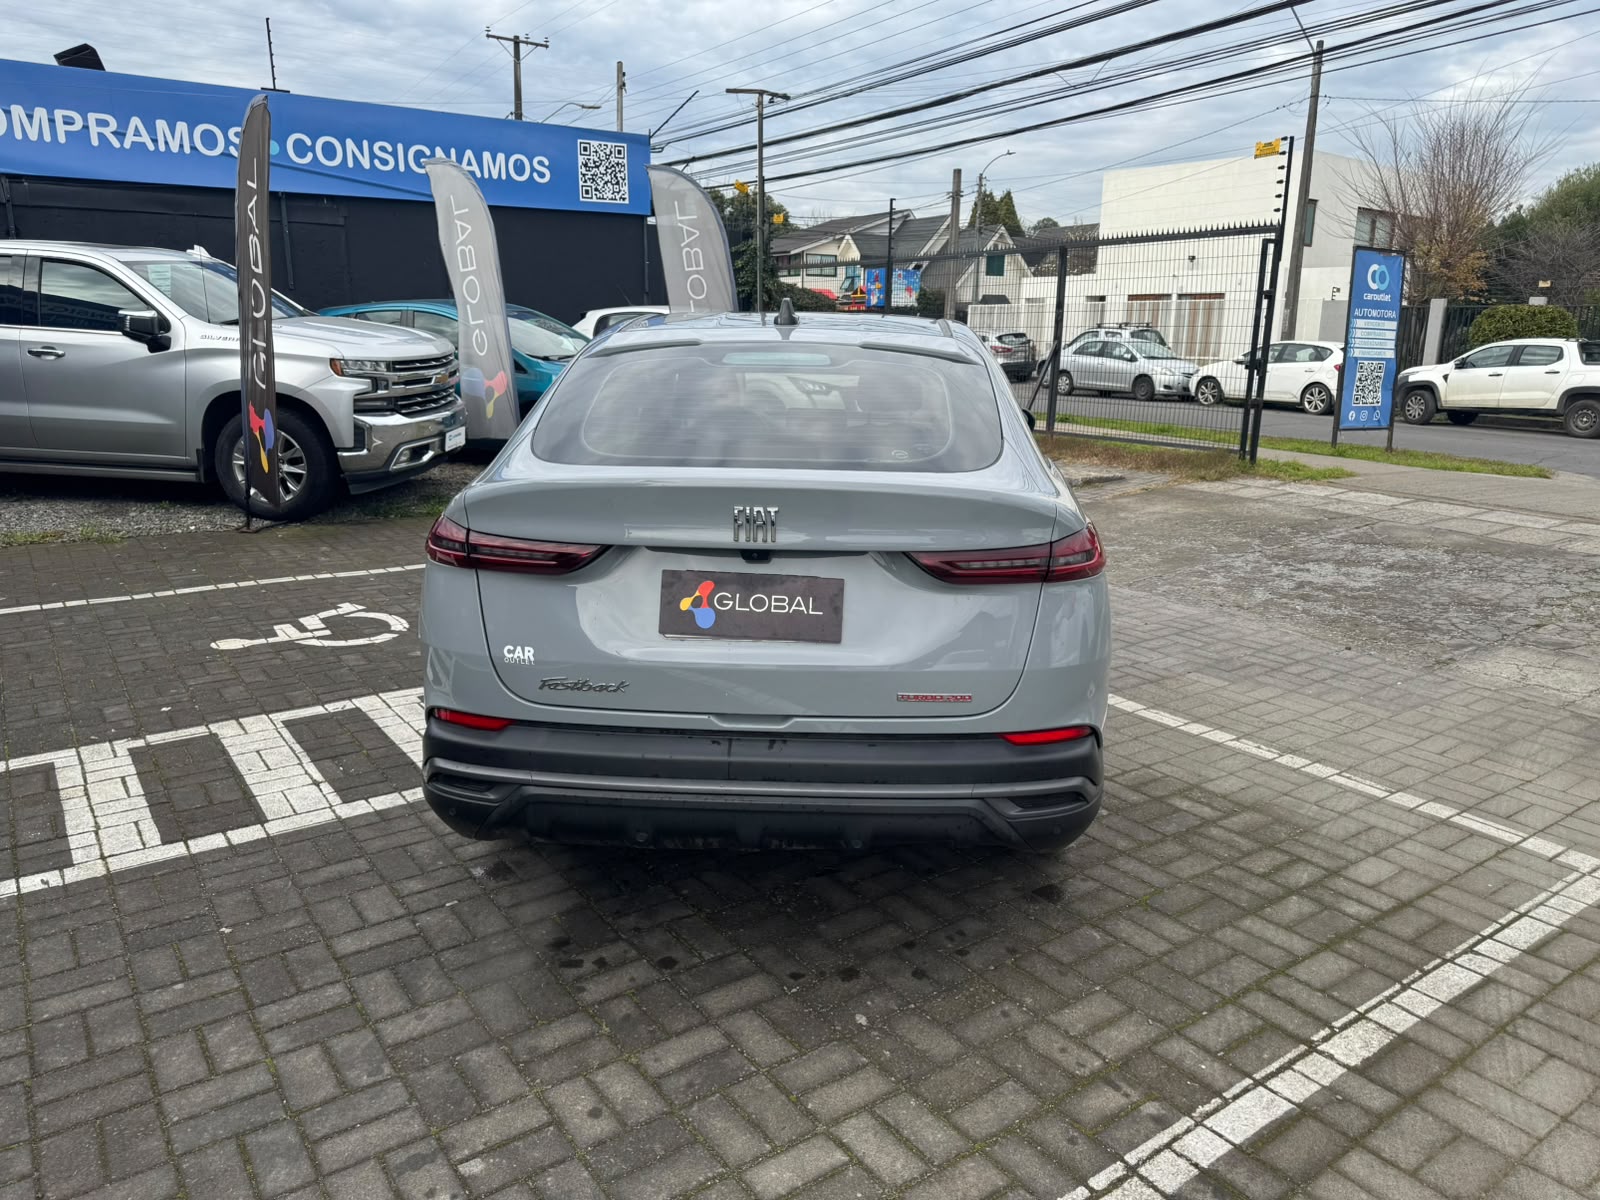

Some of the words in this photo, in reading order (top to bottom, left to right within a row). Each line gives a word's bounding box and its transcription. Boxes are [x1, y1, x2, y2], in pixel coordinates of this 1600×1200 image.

[0, 104, 242, 158] MPRAMOS
[246, 157, 266, 390] GLOBAL
[1354, 307, 1397, 319] AUTOMOTORA
[732, 505, 779, 543] FIAT
[713, 592, 824, 615] GLOBAL
[503, 644, 535, 661] CAR
[538, 676, 630, 693] Fastback
